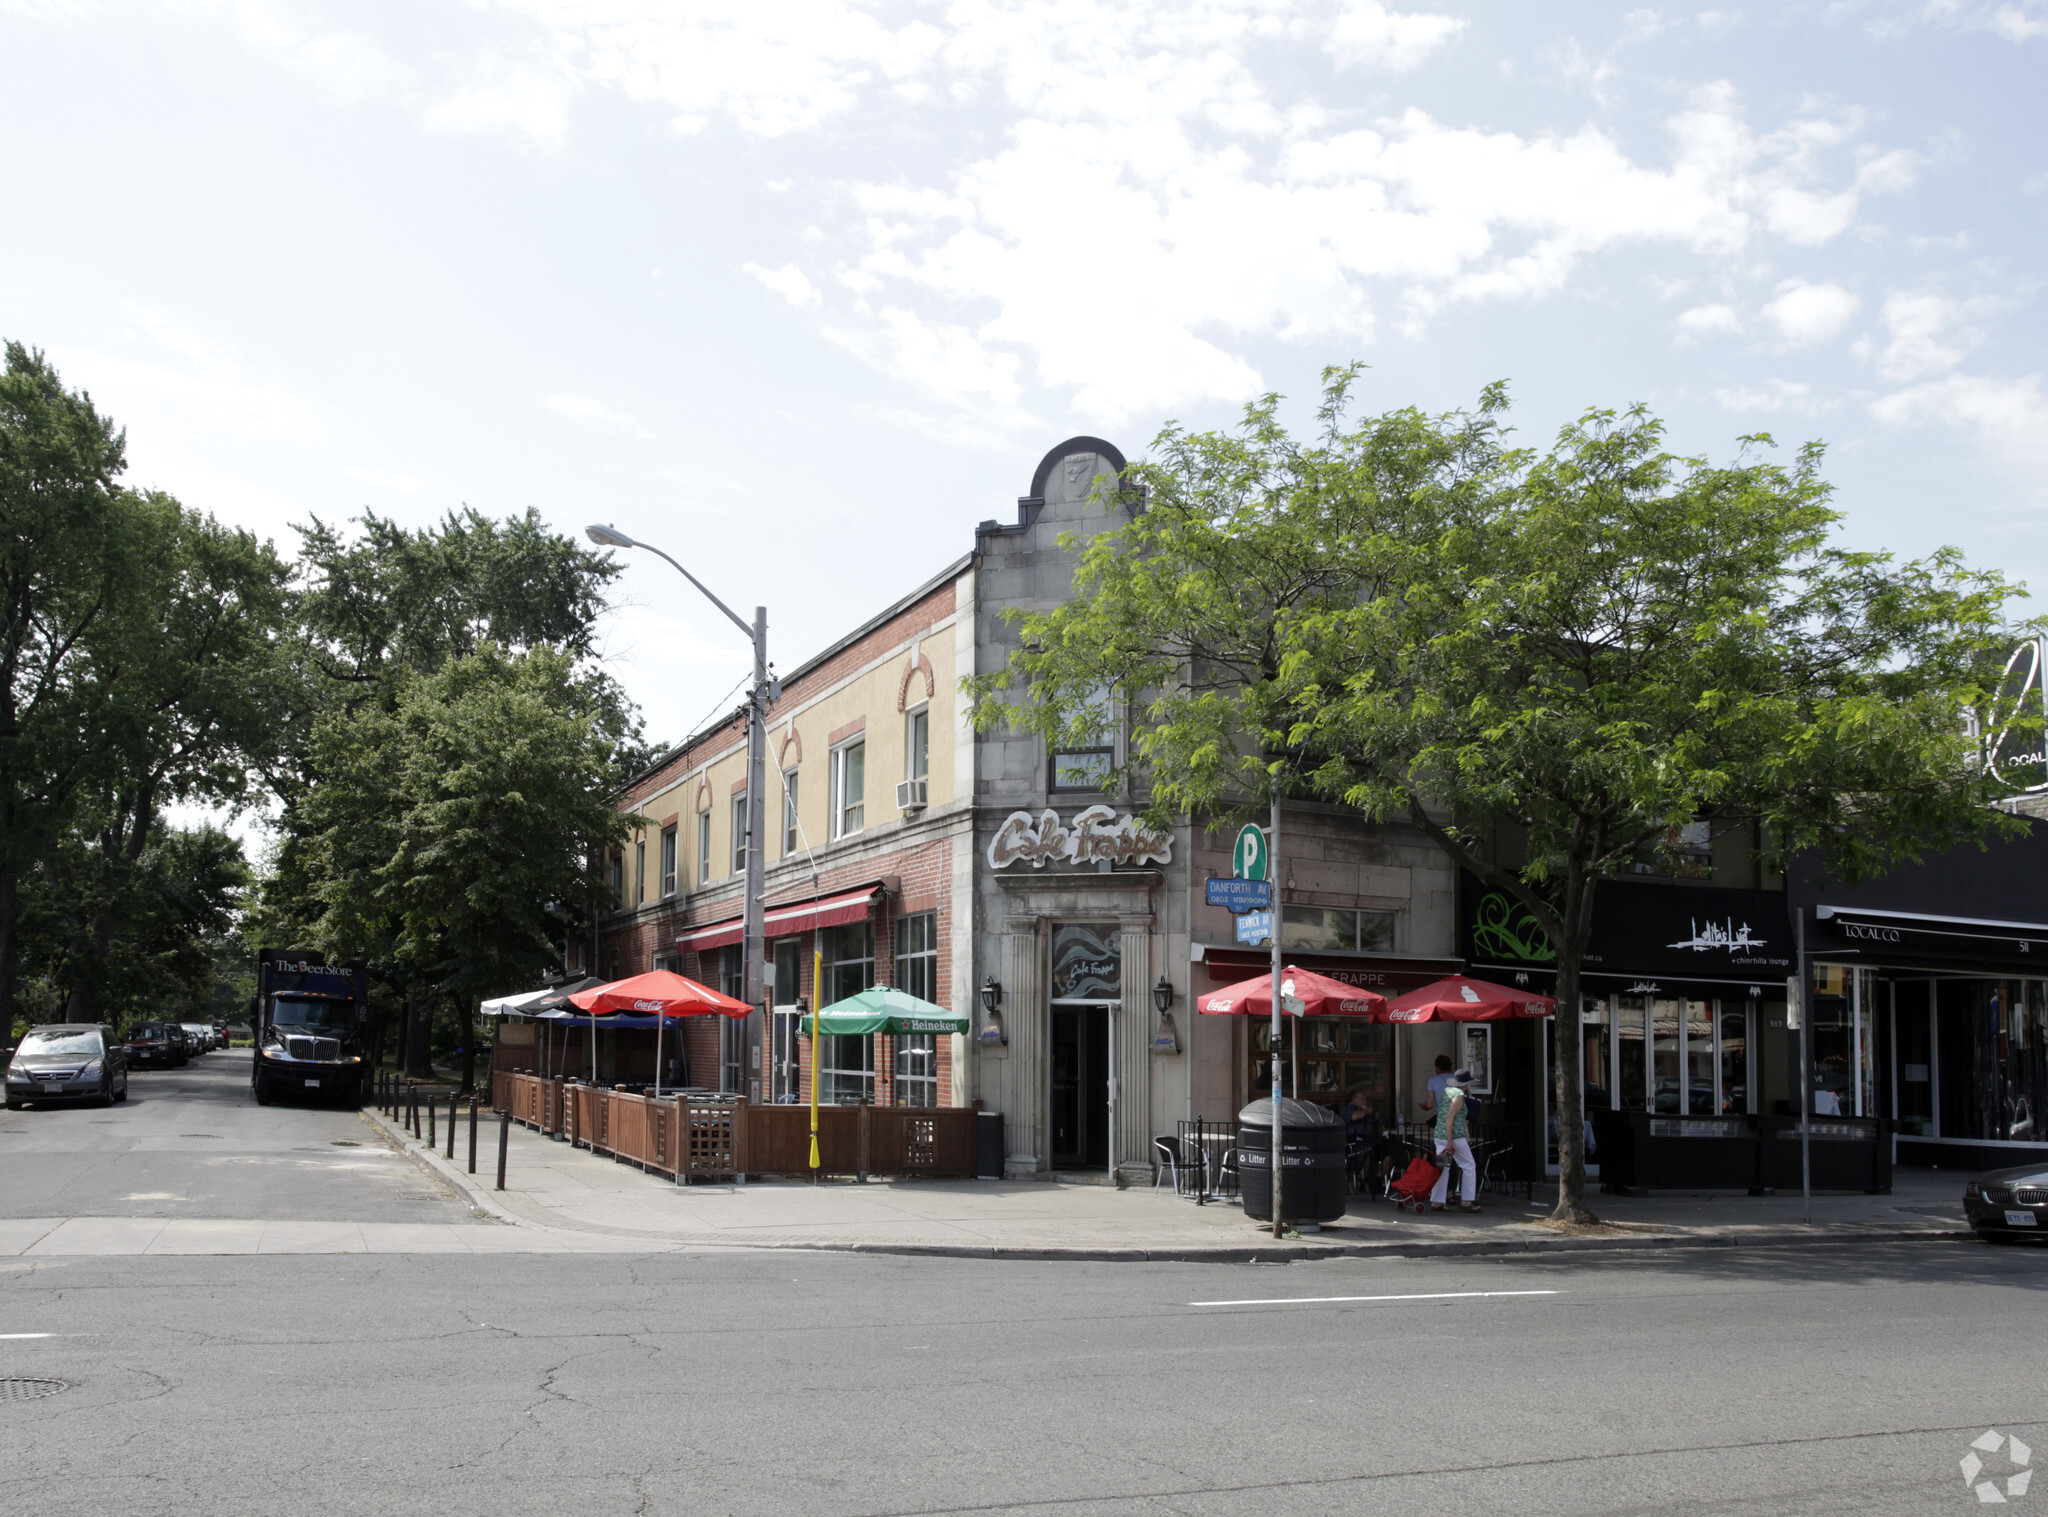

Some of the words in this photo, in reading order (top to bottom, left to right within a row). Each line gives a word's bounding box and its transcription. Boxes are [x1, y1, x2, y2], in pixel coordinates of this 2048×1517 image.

[1210, 881, 1251, 894] DANFORTH
[1239, 915, 1260, 930] FENWICK
[1845, 925, 1882, 940] LOCAL
[276, 959, 298, 973] The
[298, 960, 325, 975] Beer
[325, 964, 353, 977] Store
[1768, 957, 1790, 966] lounge
[1070, 961, 1089, 979] Cafe
[1090, 962, 1115, 976] Frappe
[911, 1019, 958, 1031] Heineken
[1248, 1154, 1266, 1164] Litter
[1282, 1156, 1301, 1166] Litter
